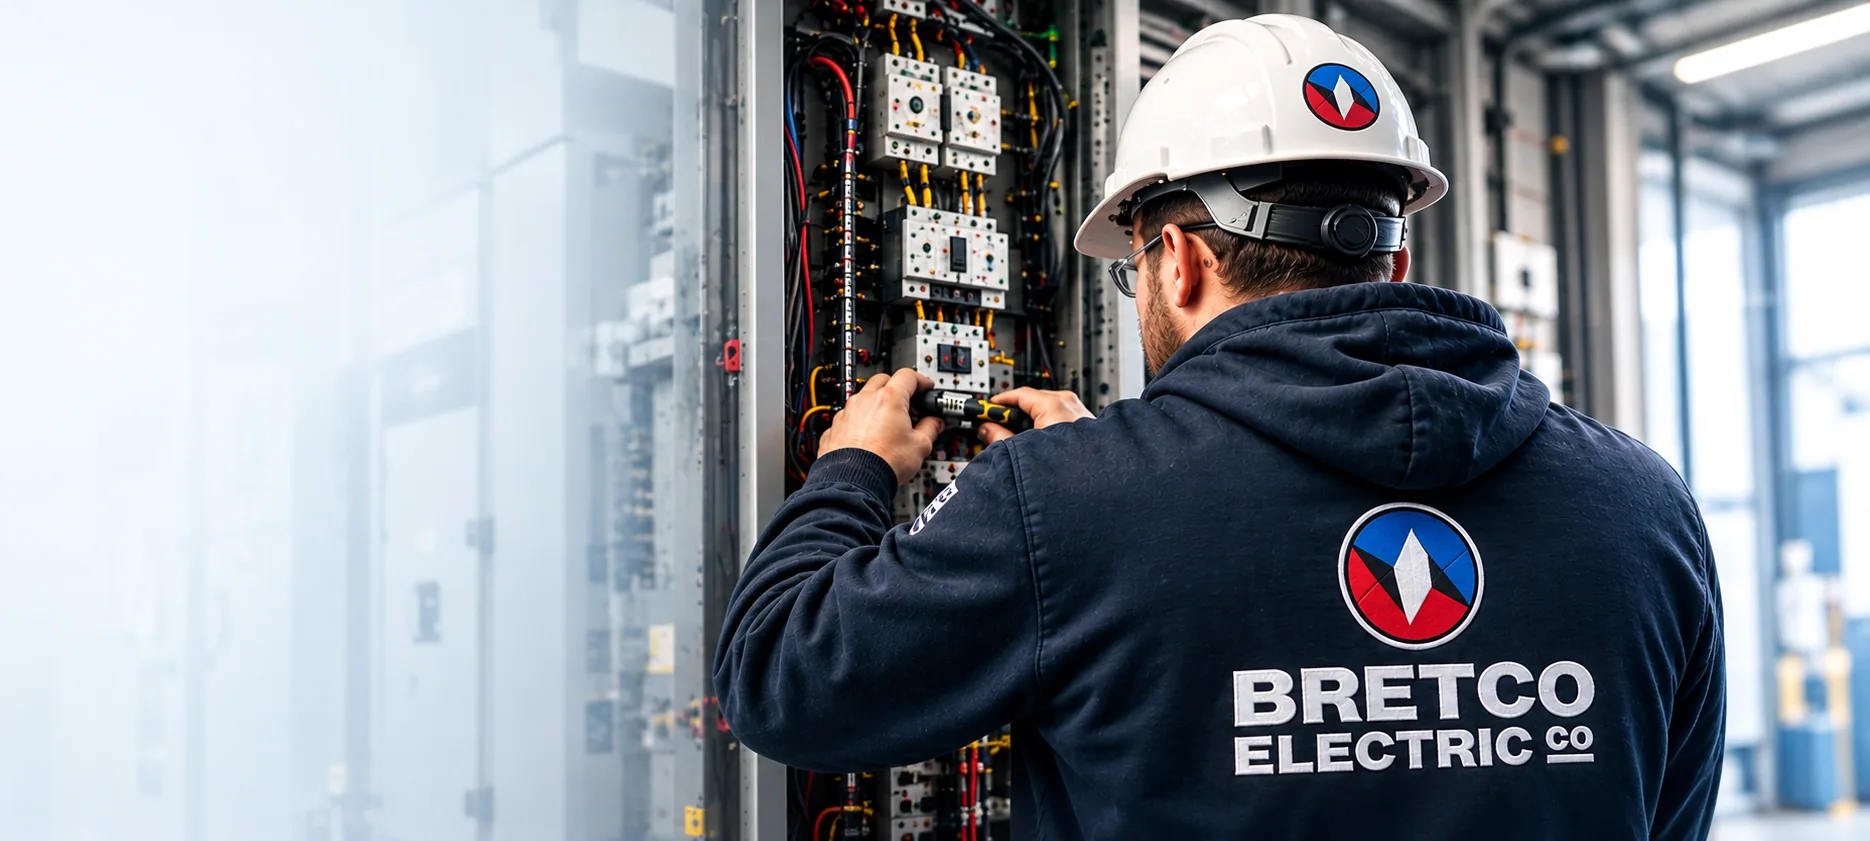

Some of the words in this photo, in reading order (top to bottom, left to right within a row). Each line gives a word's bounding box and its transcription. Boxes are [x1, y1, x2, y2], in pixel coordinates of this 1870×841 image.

[1233, 661, 1595, 727] BRETCO
[1234, 727, 1534, 775] ELECTRIC
[1545, 725, 1594, 751] CO
